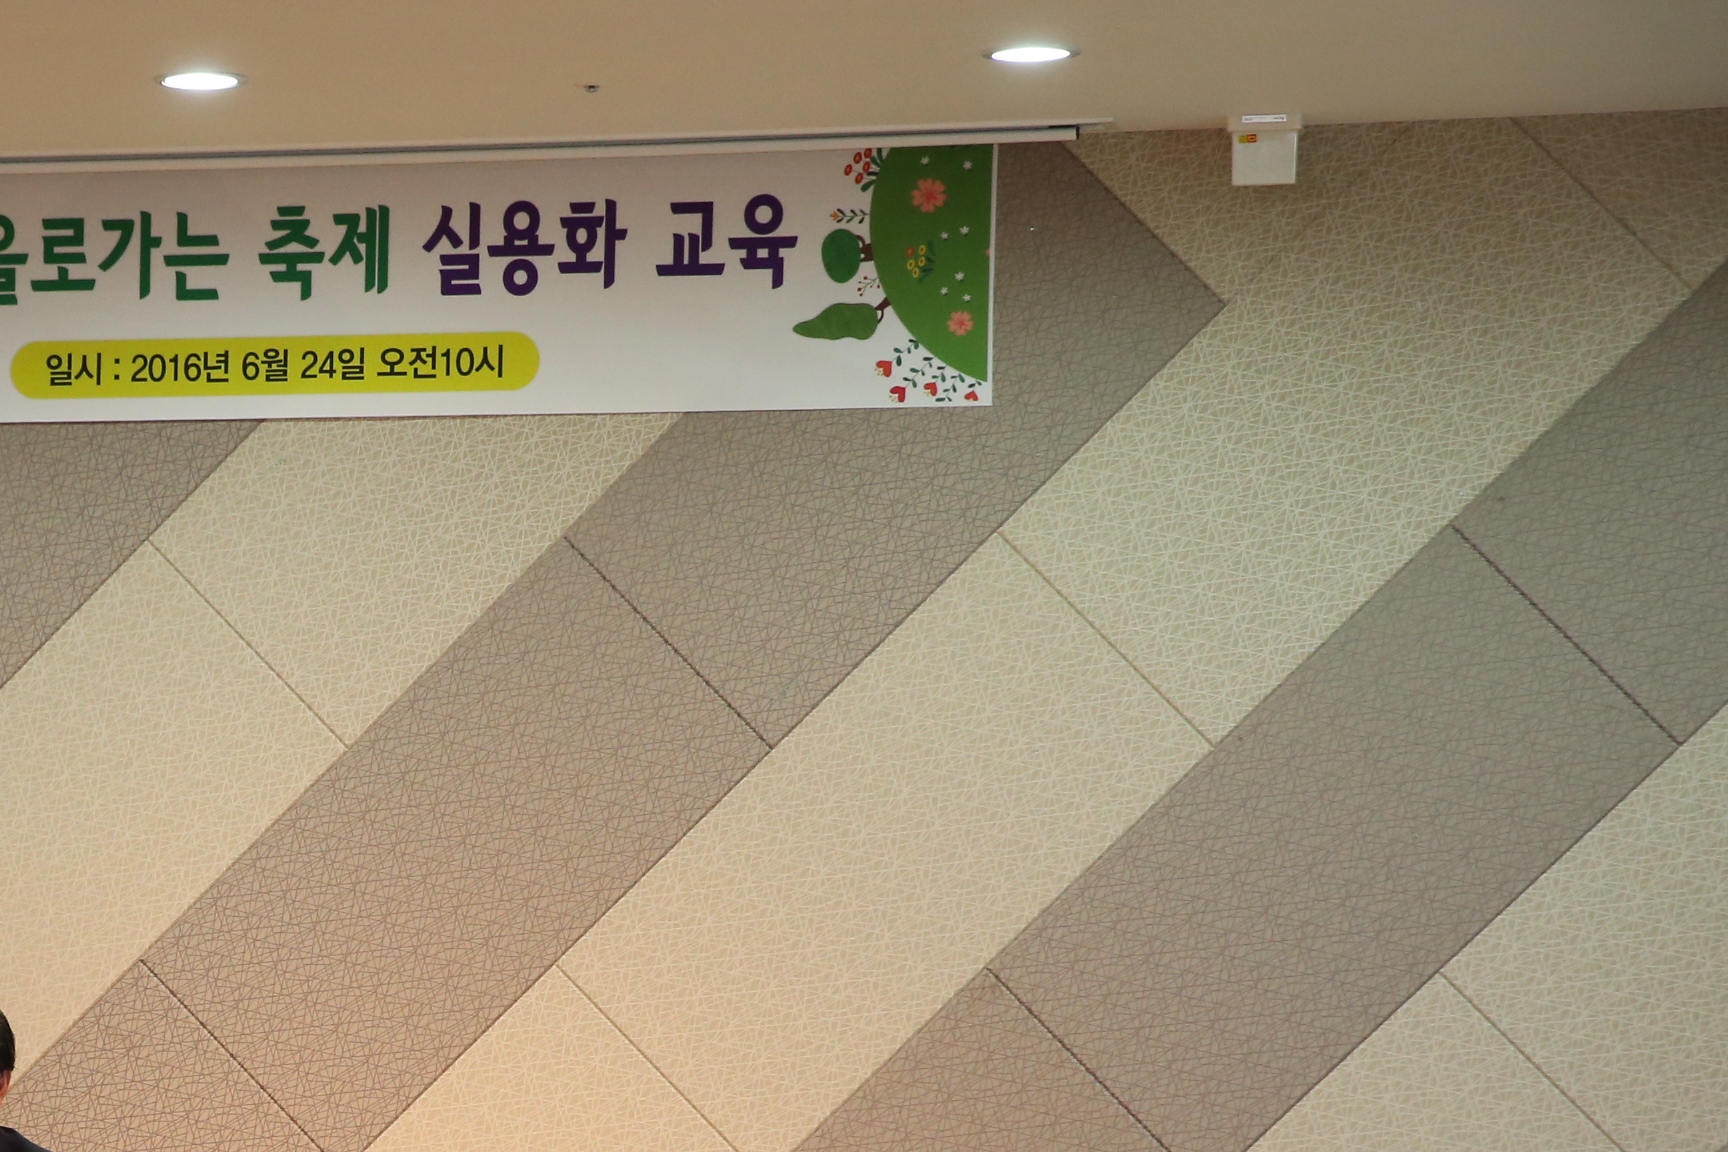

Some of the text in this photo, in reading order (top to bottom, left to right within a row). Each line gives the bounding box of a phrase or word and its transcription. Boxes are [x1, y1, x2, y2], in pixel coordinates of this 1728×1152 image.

[258, 204, 390, 301] 축제
[422, 198, 628, 297] 실용화
[656, 193, 799, 290] 교육
[130, 350, 230, 384] 2016년
[241, 348, 289, 383] 6월
[300, 347, 366, 381] 24일
[376, 344, 504, 379] 오전10시
